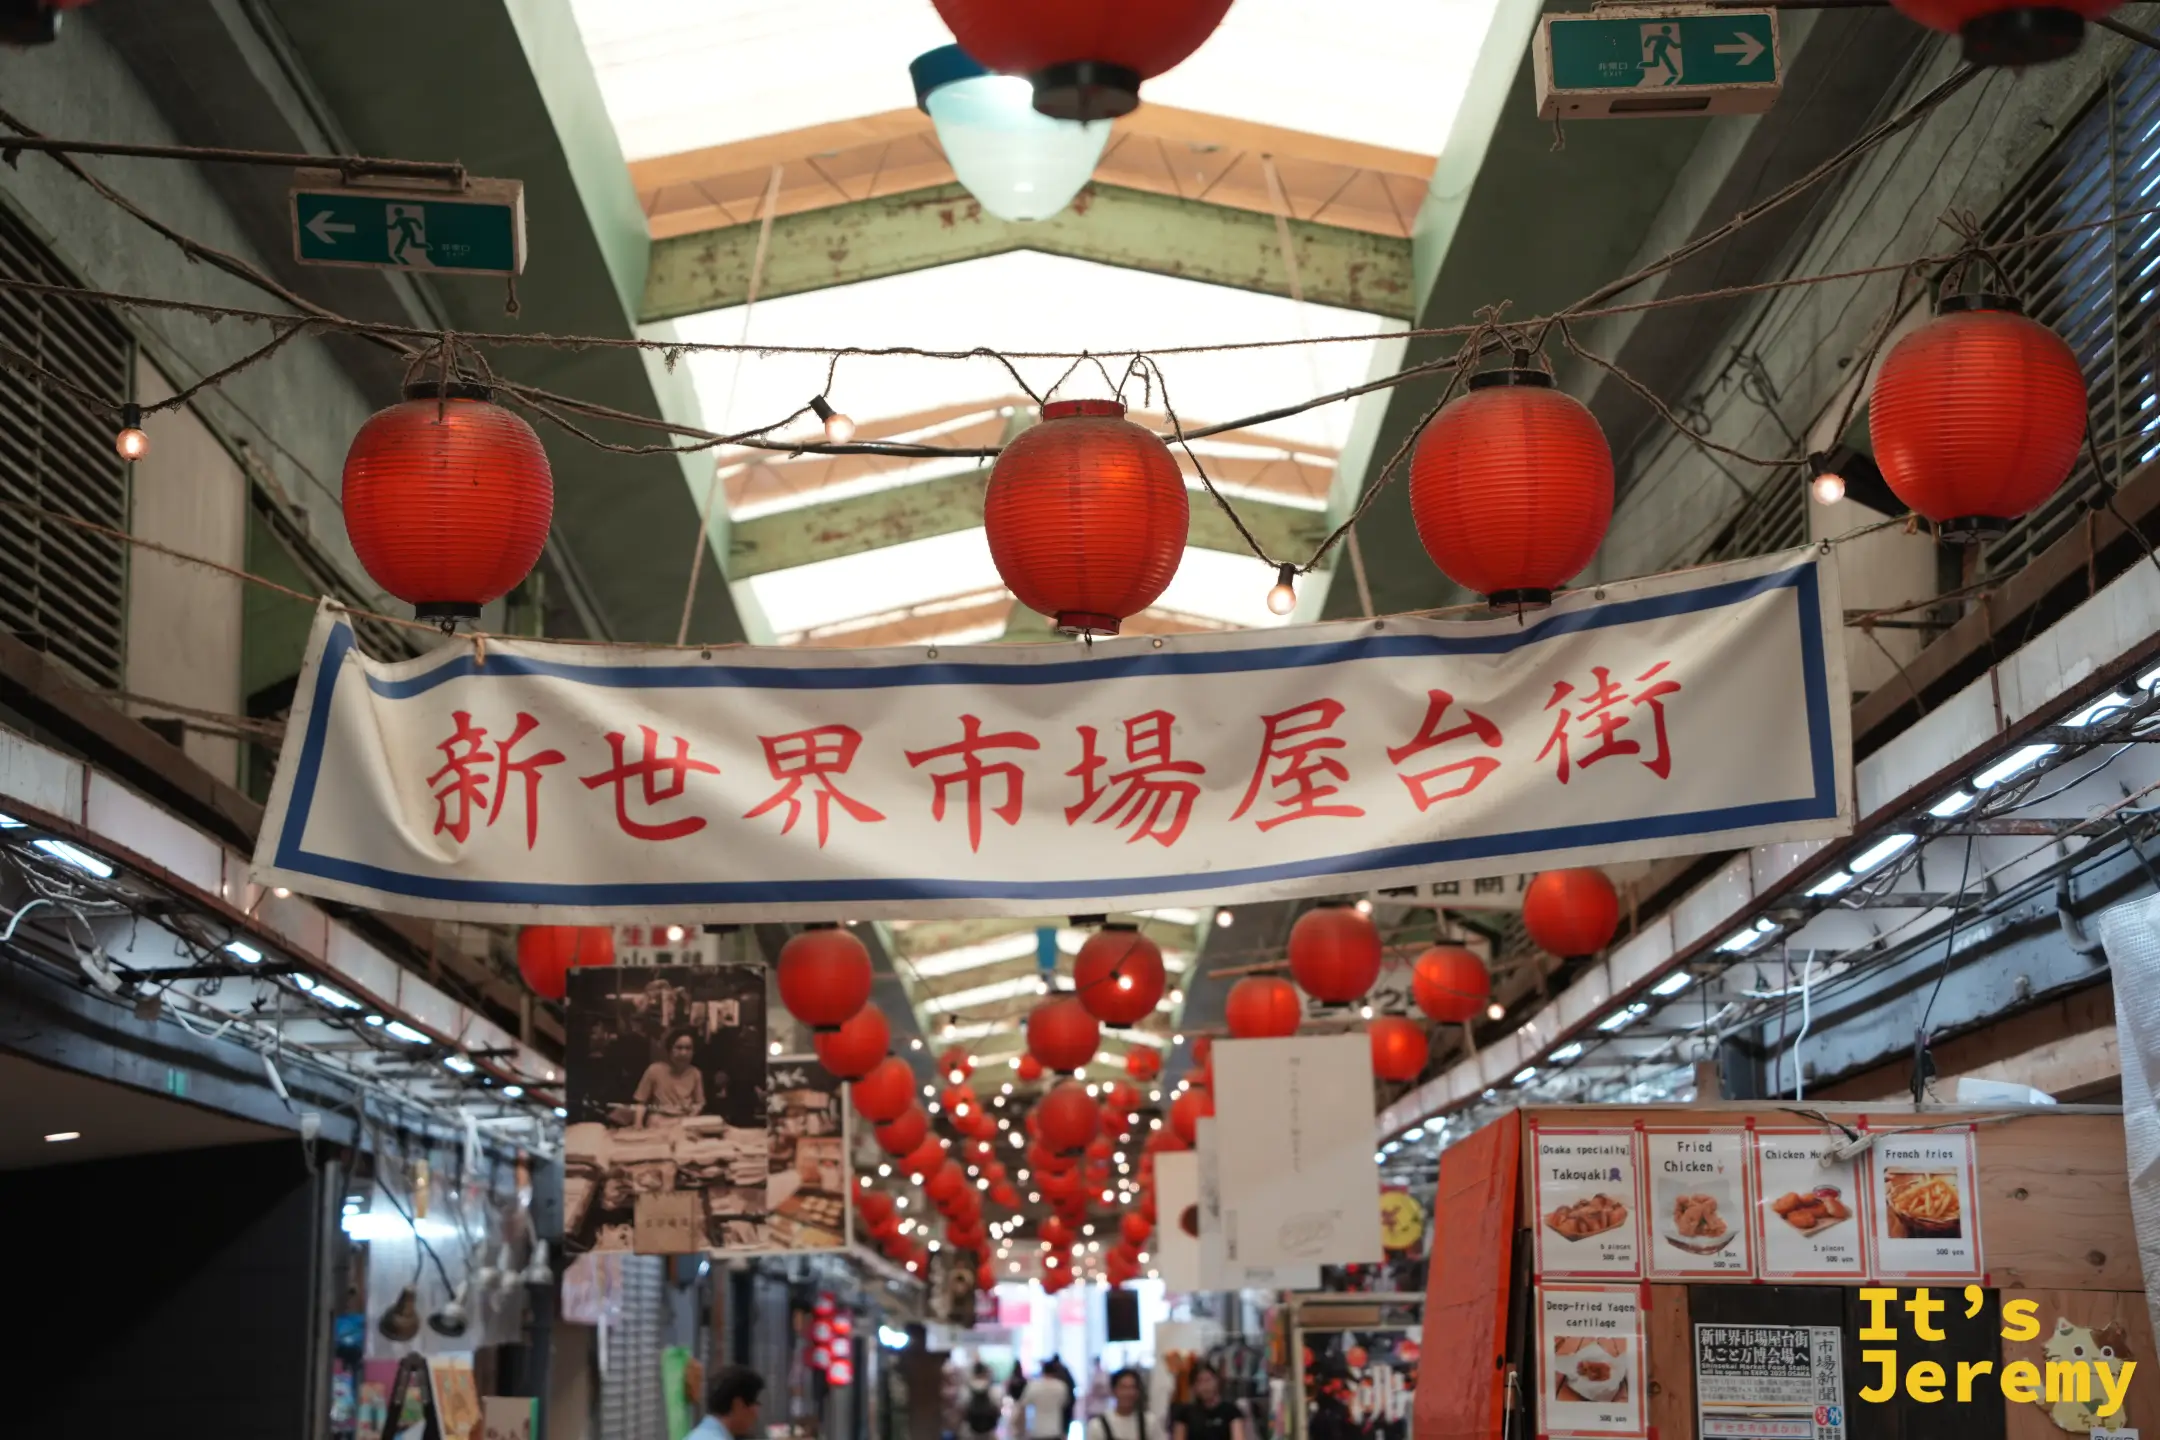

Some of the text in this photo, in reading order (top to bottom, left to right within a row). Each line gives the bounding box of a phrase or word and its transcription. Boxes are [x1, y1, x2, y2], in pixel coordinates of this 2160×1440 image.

[427, 661, 1680, 852] 新世界市場屋台街
[1677, 1141, 1713, 1153] Fried
[1765, 1150, 1805, 1159] Chicken
[1885, 1149, 1953, 1160] French fries
[1664, 1160, 1713, 1173] Chicken
[1552, 1168, 1607, 1181] Takoyaki
[1936, 1248, 1949, 1256] 500
[1546, 1301, 1635, 1313] Deep-fried Yagen
[1566, 1318, 1616, 1328] cartilage
[1700, 1328, 1808, 1348] 新世界市場屋台街
[1701, 1346, 1809, 1364] 丸ごと万博会場へ
[1815, 1339, 1837, 1402] 市場新聞
